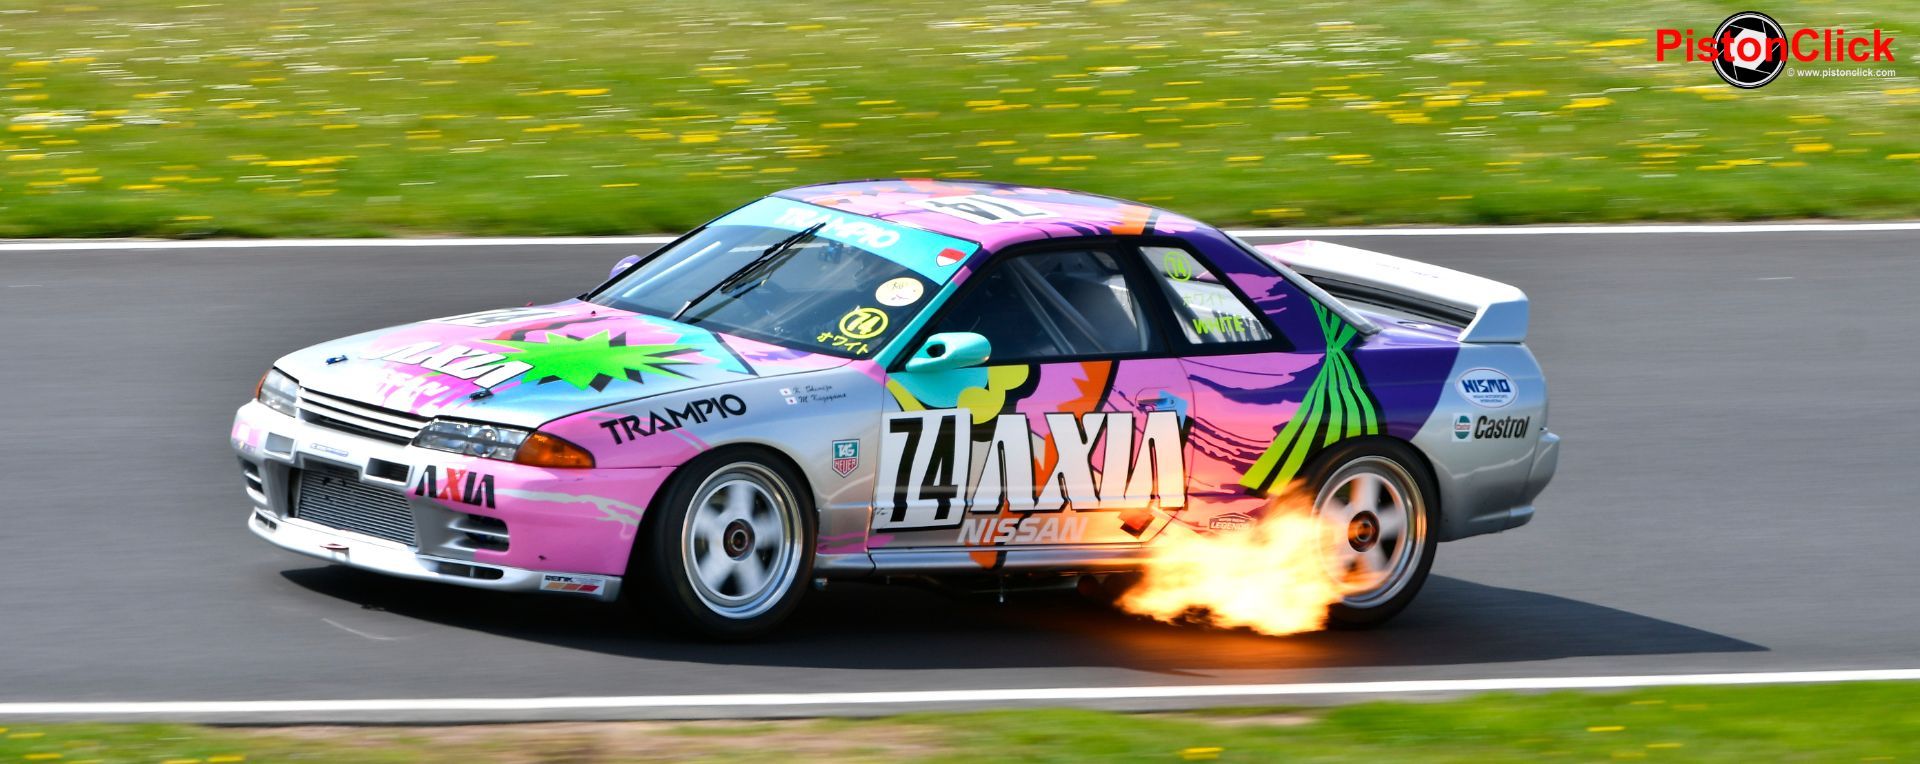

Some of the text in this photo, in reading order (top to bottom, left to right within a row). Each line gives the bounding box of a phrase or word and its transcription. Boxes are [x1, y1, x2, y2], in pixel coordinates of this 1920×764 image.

[774, 207, 900, 249] TRAMPIO
[846, 310, 881, 335] 74
[1192, 314, 1245, 335] WHITE
[1461, 379, 1511, 393] NISMO
[598, 394, 747, 445] TRAMPIO
[1474, 415, 1530, 439] Castrol
[837, 443, 855, 457] TAG
[969, 410, 1188, 513] AXIA
[834, 459, 857, 474] HEUER
[888, 415, 957, 522] 74
[415, 464, 496, 509] AXIA
[957, 516, 1088, 544] NISSAN
